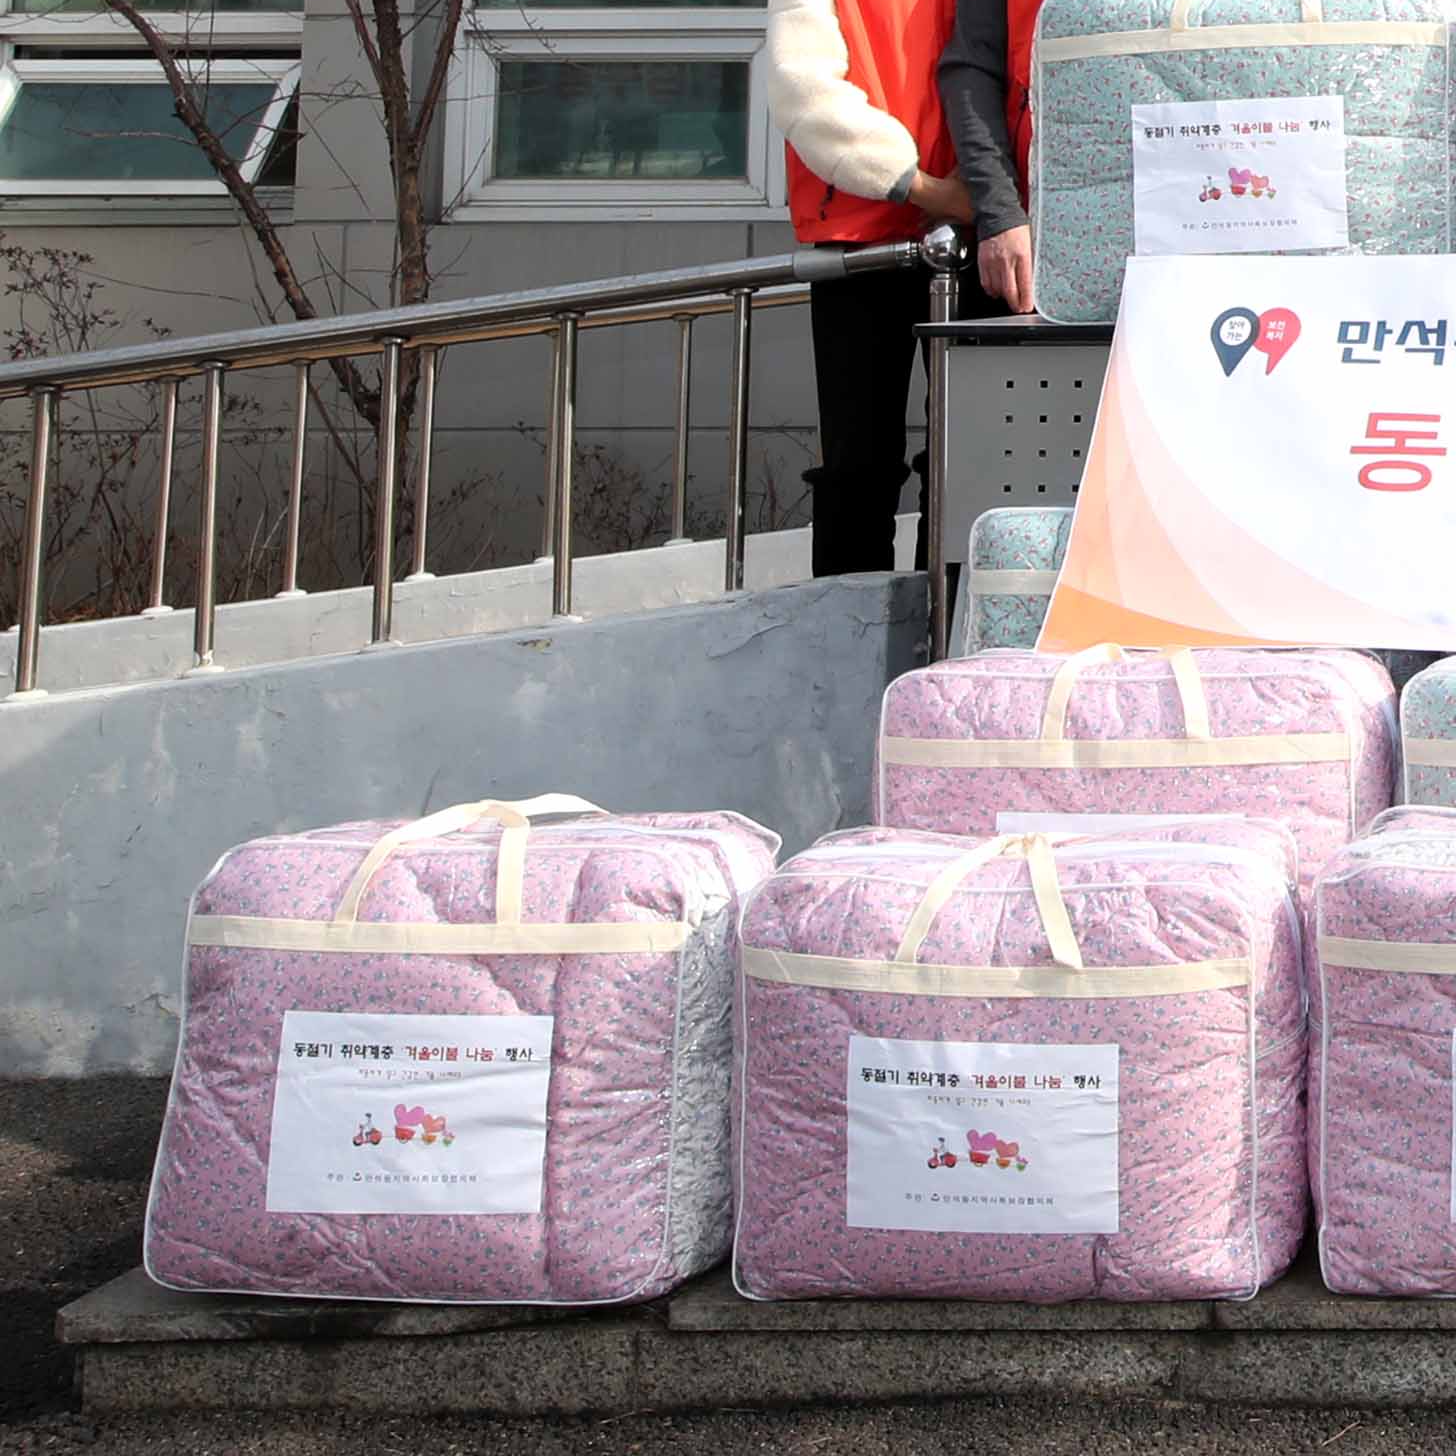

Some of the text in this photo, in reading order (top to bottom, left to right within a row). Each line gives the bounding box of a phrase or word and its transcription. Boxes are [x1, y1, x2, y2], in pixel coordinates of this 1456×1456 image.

[294, 1043, 333, 1057] 동절기
[340, 1044, 394, 1060] 취약계층
[505, 1047, 532, 1062] 행사
[861, 1068, 900, 1084] 동절기
[907, 1072, 960, 1087] 취약계층
[1074, 1076, 1100, 1089] 행사
